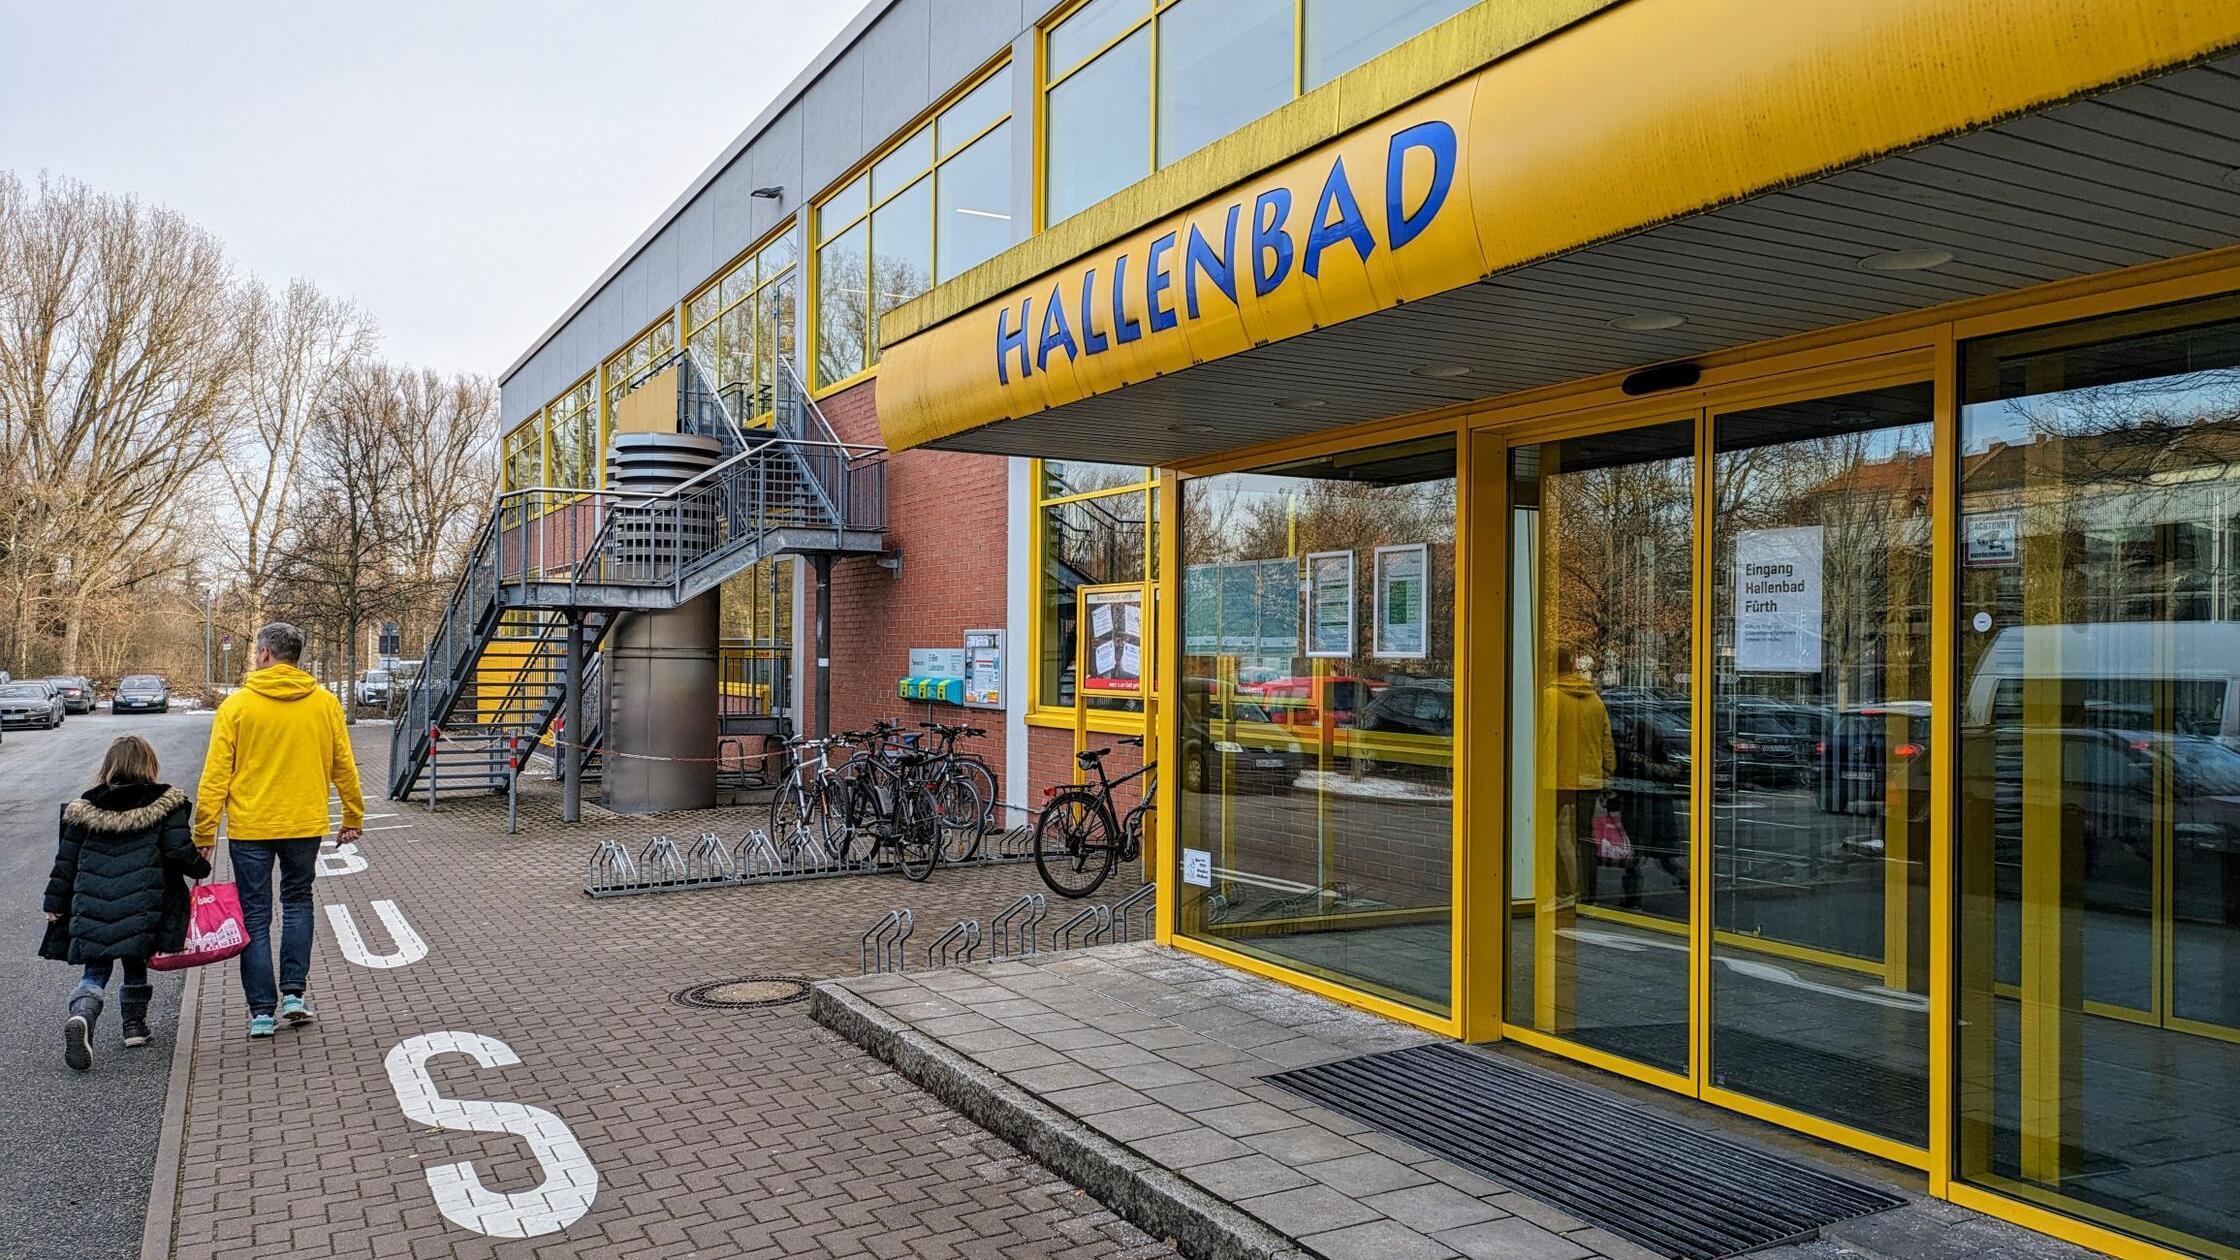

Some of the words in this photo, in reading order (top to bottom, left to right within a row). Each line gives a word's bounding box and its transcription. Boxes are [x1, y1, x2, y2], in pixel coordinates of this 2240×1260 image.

[996, 120, 1458, 386] HALLENBAD
[1745, 563, 1793, 578] Eingang
[1745, 579, 1805, 594] Hallenbad
[1745, 599, 1778, 613] Fürth
